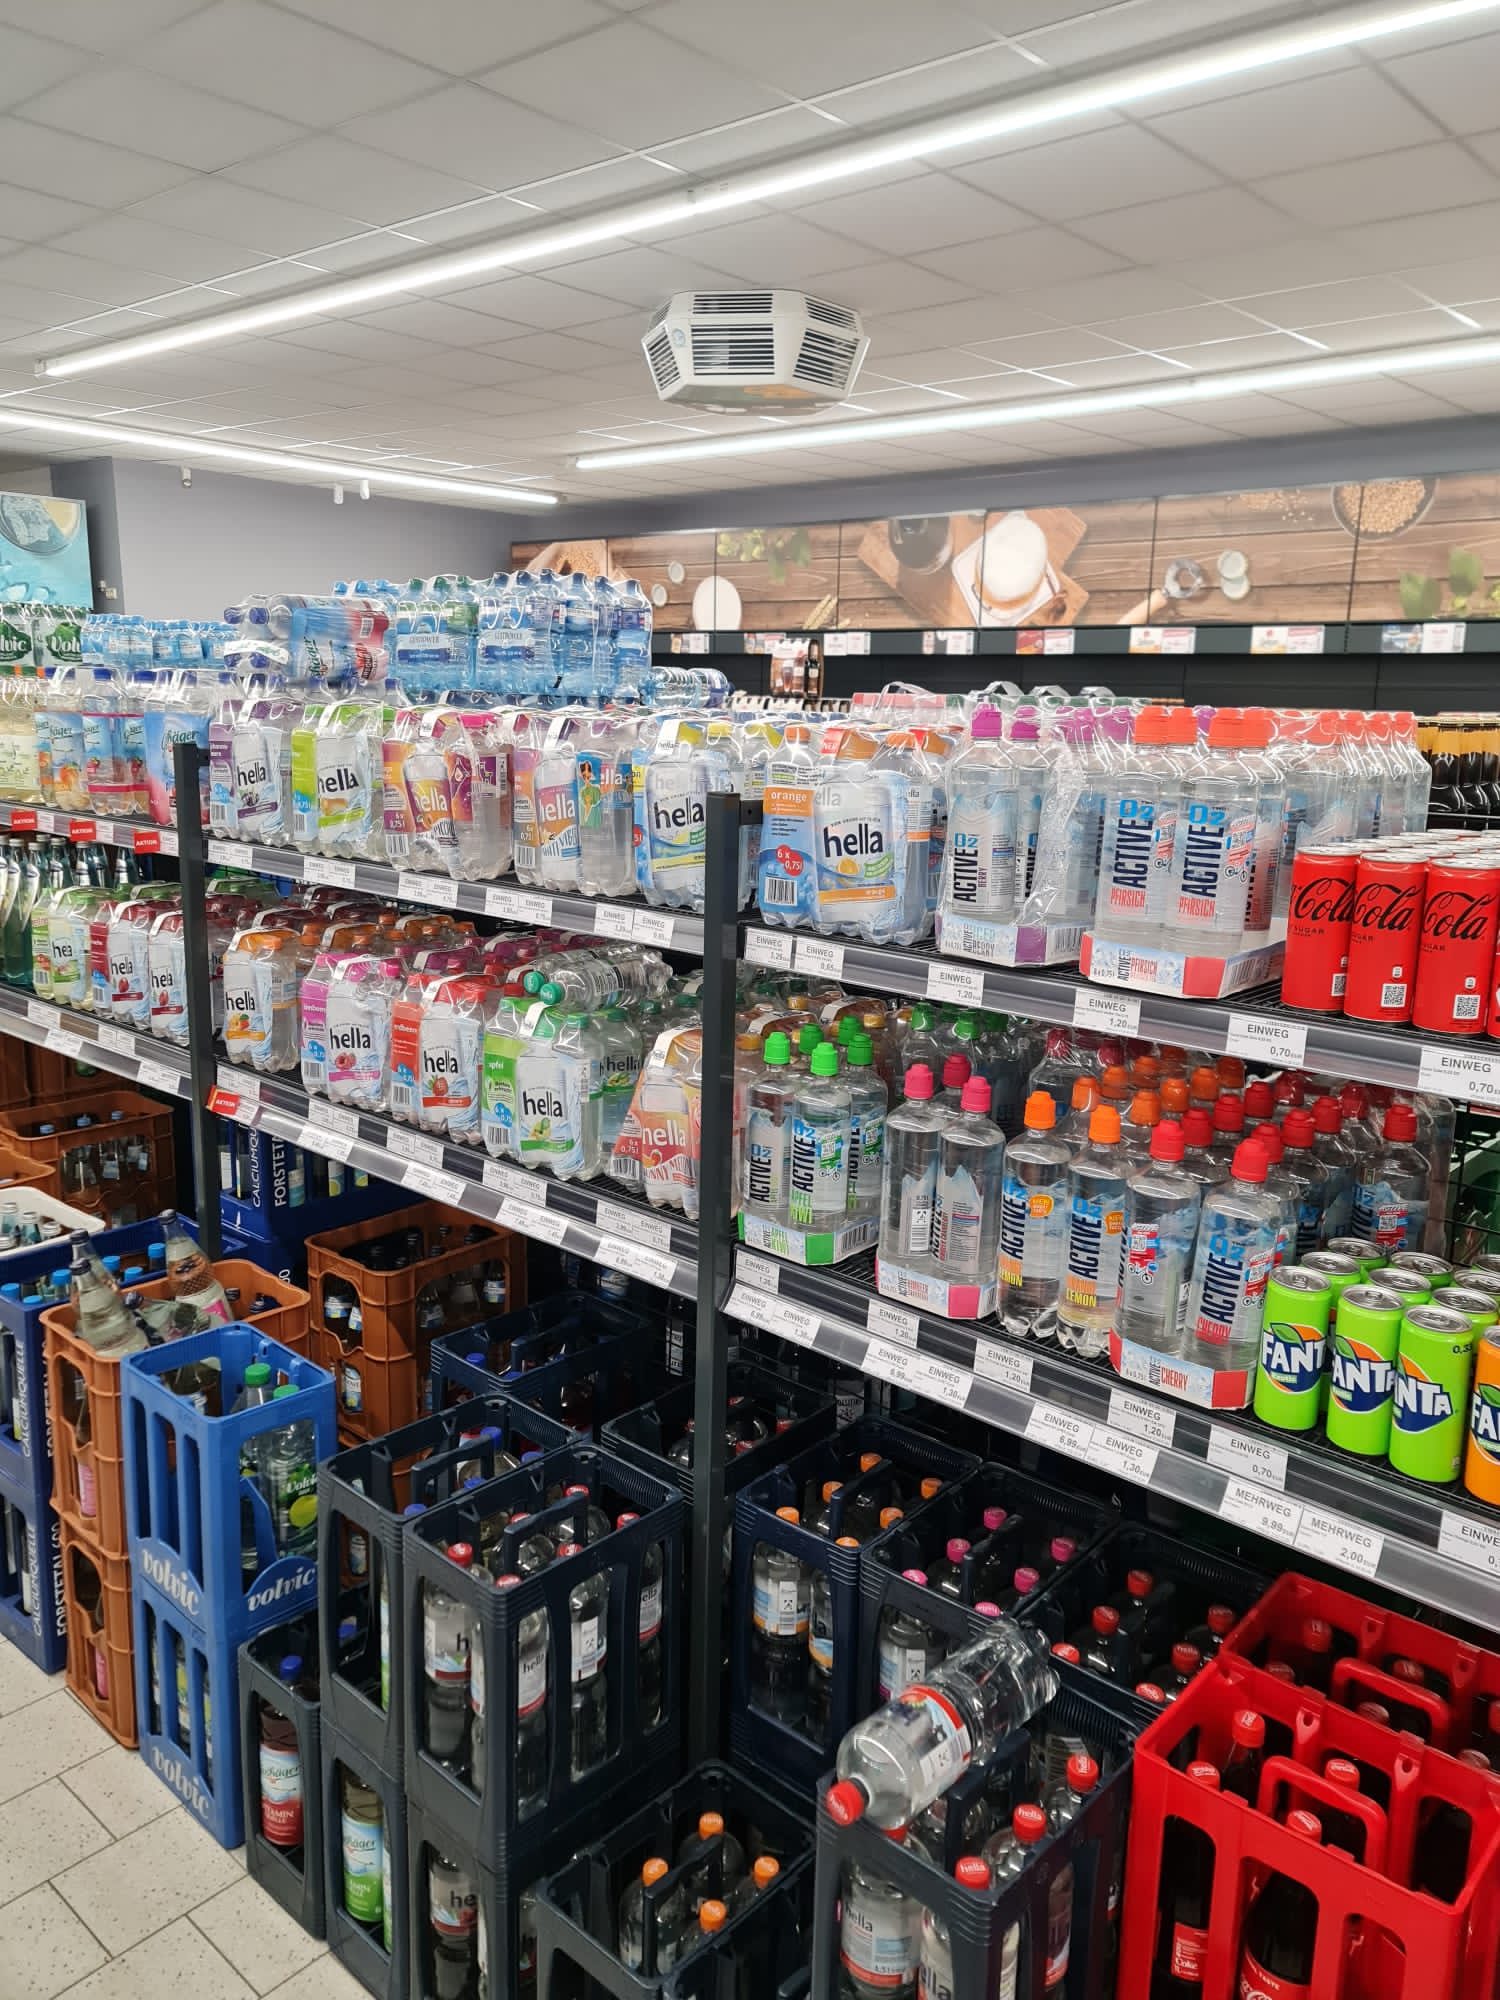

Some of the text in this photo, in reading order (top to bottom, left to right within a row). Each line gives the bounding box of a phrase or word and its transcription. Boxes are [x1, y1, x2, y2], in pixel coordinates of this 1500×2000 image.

[238, 762, 266, 787] hella
[771, 791, 807, 803] orange
[654, 798, 705, 829] hella
[824, 823, 883, 858] hella
[1113, 800, 1155, 889] O2 ACTIVE
[1181, 804, 1226, 898] O2 ACTIVE
[777, 850, 783, 859] 6
[953, 848, 979, 903] ACTIVE
[977, 867, 987, 888] BERRY
[1110, 887, 1146, 907] PFIRSICH
[1178, 896, 1216, 917] PFIRSICH
[1351, 883, 1423, 931] Cola
[642, 917, 665, 928] EINWEG
[1424, 891, 1496, 940] Cola
[756, 936, 783, 948] EINWEG
[806, 945, 833, 958] EINWEG
[940, 971, 972, 985] EINWEG
[1089, 999, 1126, 1013] EINWEG
[1109, 1017, 1127, 1028] 1,20
[1247, 1024, 1289, 1039] EINWEG
[329, 1028, 371, 1050] hella
[424, 1050, 458, 1074] hella
[1270, 1046, 1290, 1057] 0,70
[1441, 1056, 1492, 1073] EINWEG
[1469, 1081, 1494, 1094] 0,70
[523, 1090, 563, 1118] hella
[792, 1135, 816, 1193] ACTIVE
[750, 1155, 772, 1203] ACTIVE
[604, 1208, 626, 1220] EINWEG
[790, 1206, 813, 1225] KIWI
[640, 1220, 663, 1233] EINWEG
[1000, 1195, 1026, 1260] ACTIVE
[1068, 1212, 1102, 1280] ACTIVE
[745, 1259, 770, 1273] EINWEG
[999, 1268, 1023, 1287] LEMON
[1199, 1233, 1245, 1324] O2 ACTIVE
[741, 1292, 766, 1308] EINWEG
[1066, 1287, 1097, 1308] LEMON
[783, 1310, 811, 1325] EINWEG
[879, 1309, 908, 1325] EINWEG
[1197, 1316, 1231, 1339] CHERRY
[878, 1349, 908, 1367] EINWEG
[988, 1349, 1021, 1368] EINWEG
[929, 1366, 960, 1384] EINWEG
[1005, 1370, 1021, 1382] 1,20
[1160, 1366, 1189, 1392] CHERRY
[15, 1341, 31, 1458] CALCIUMQUELLE
[1396, 1376, 1451, 1416] NTA
[1123, 1400, 1161, 1421] EINWEG
[1043, 1412, 1080, 1433] EINWEG
[1143, 1423, 1161, 1437] 1,20
[1059, 1434, 1077, 1447] 6,99
[1105, 1436, 1143, 1457] EINWEG
[1230, 1438, 1271, 1460] EINWEG
[1122, 1459, 1141, 1475] 1,30
[1252, 1464, 1273, 1478] 0,70
[1236, 1487, 1292, 1518] MEHRWEG
[1262, 1517, 1283, 1533] 9,99
[1311, 1517, 1372, 1548] MEHRWEG
[1341, 1547, 1364, 1563] 2,00
[25, 1526, 43, 1637] CALCIUMQUELLE
[141, 1548, 200, 1616] volvic
[247, 1566, 316, 1612] volvic
[153, 1746, 211, 1820] volvic
[1018, 1807, 1042, 1821] hella
[960, 1862, 986, 1874] hella
[846, 1903, 873, 1933] hella
